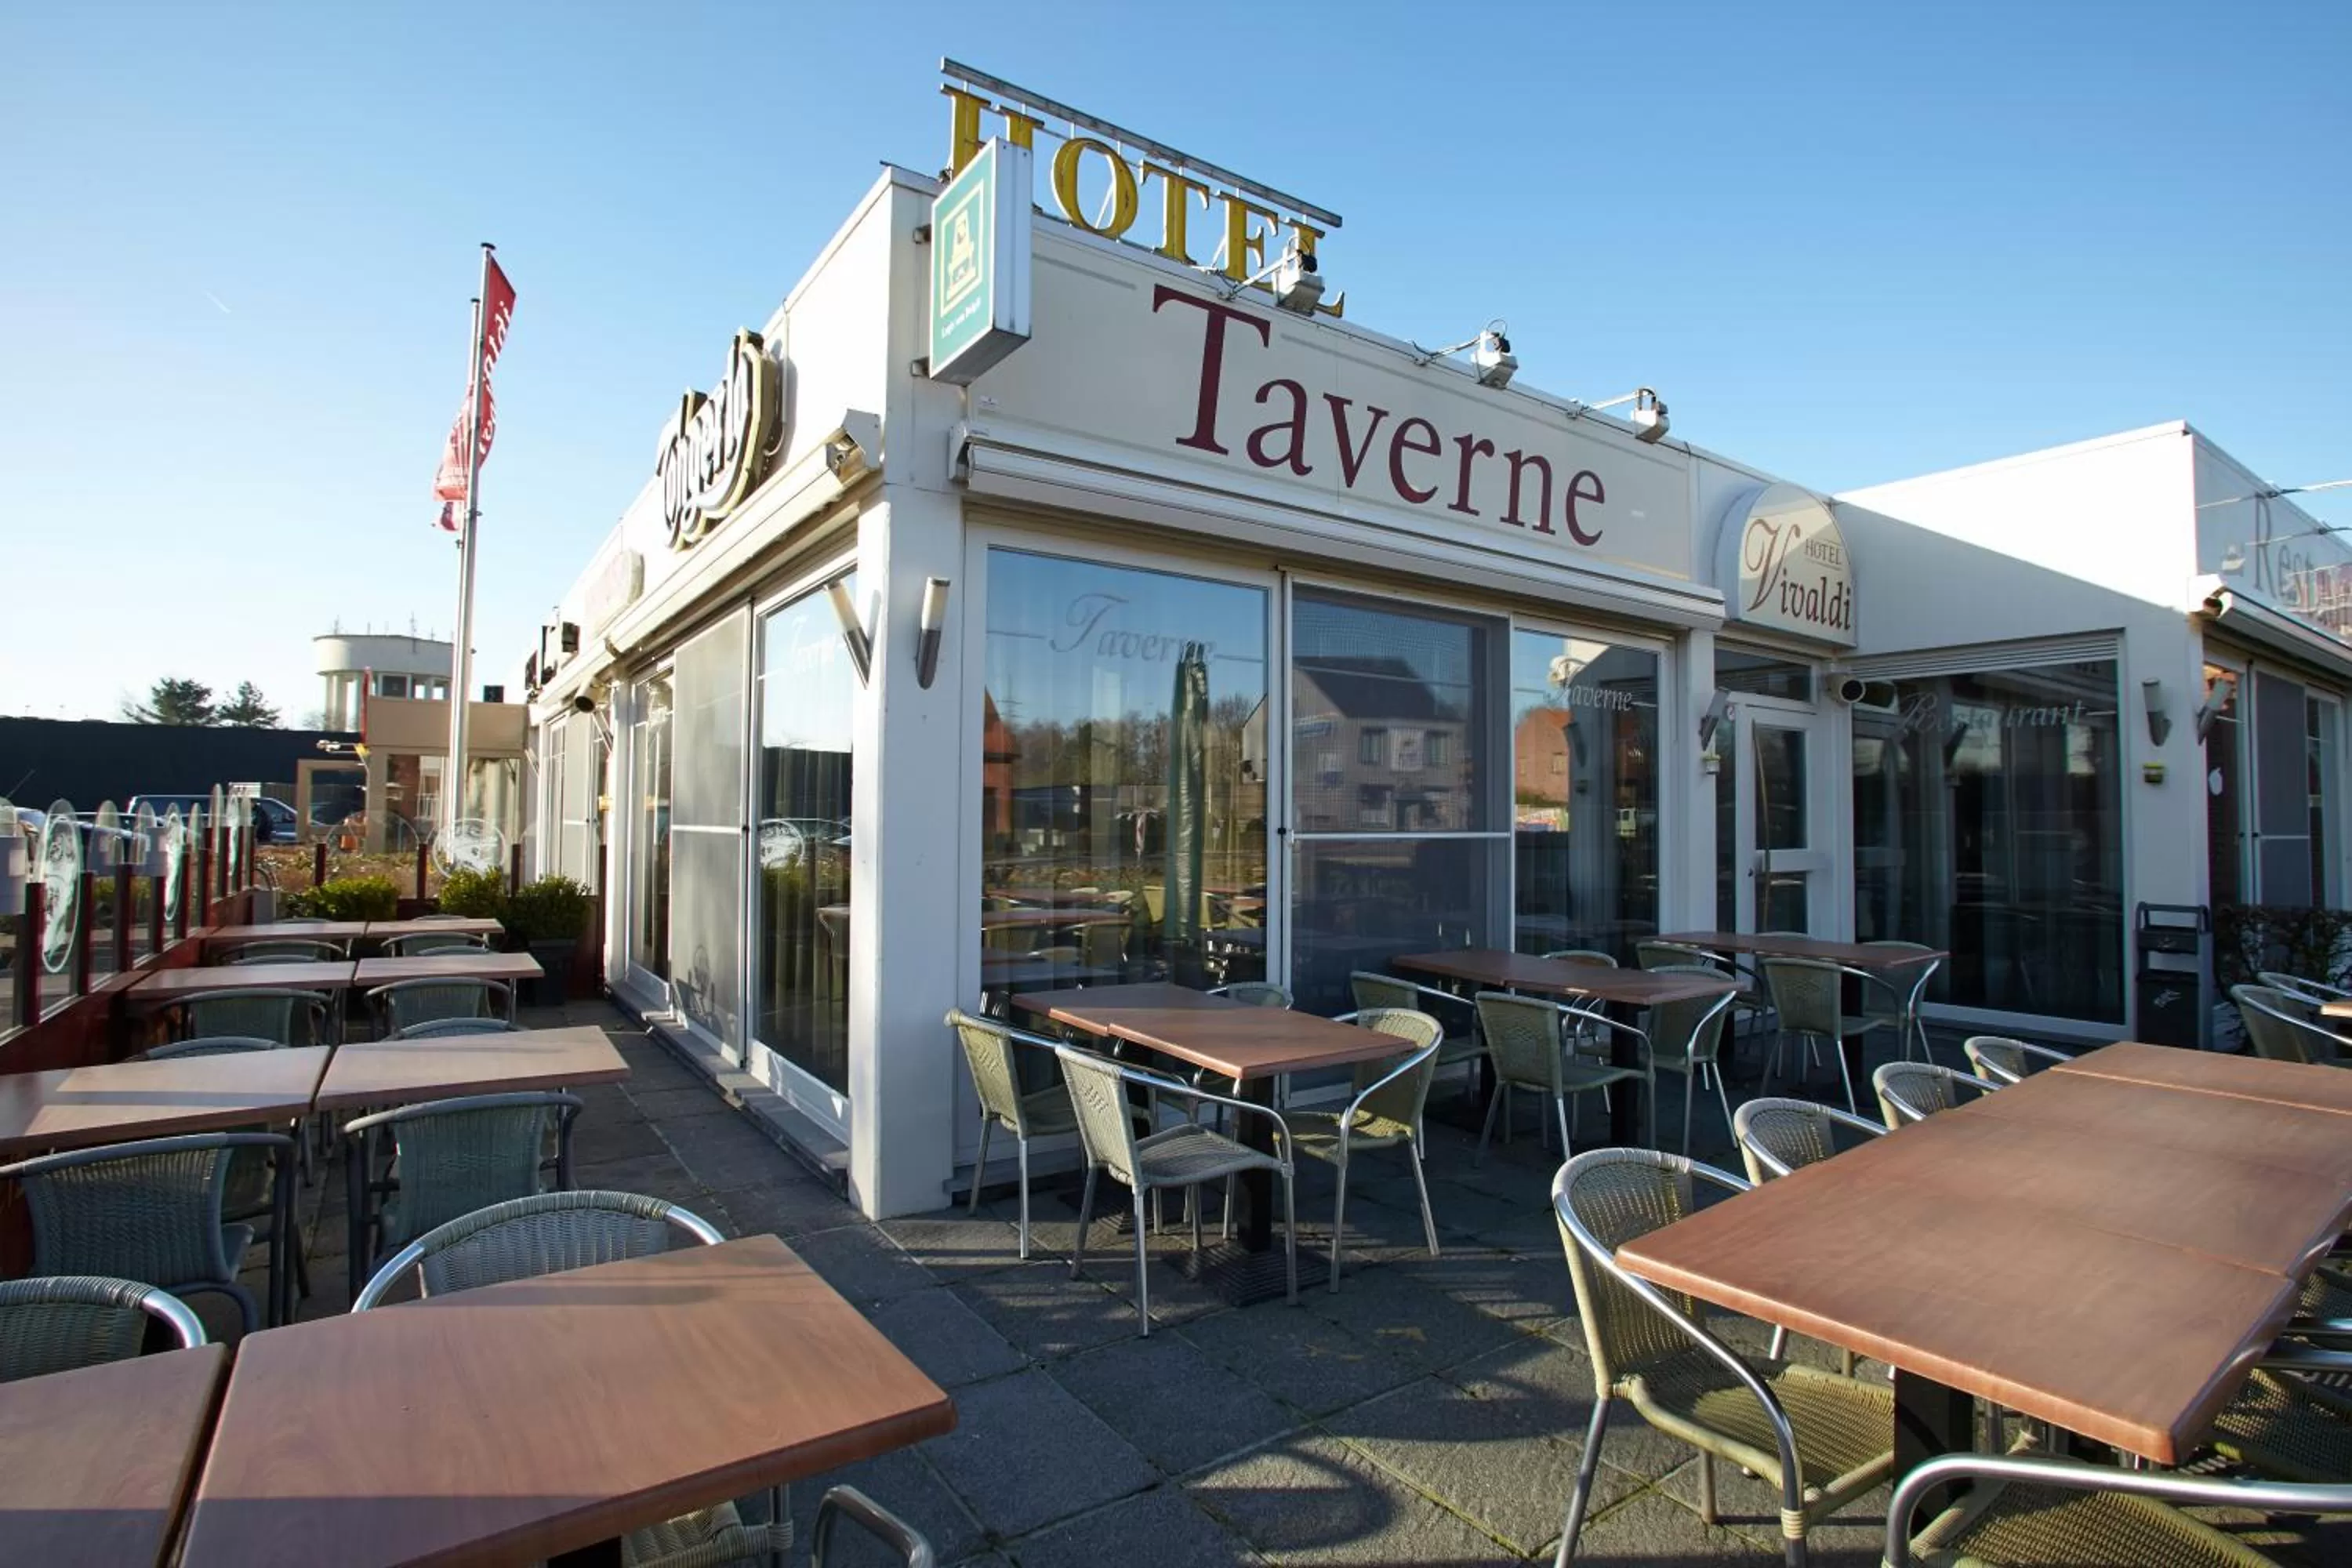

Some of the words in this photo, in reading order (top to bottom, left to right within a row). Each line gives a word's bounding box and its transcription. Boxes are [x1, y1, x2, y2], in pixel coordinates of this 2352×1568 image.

[1152, 283, 1606, 547] Taverne
[1744, 518, 1851, 630] Vivaldi
[1805, 539, 1842, 566] HOTEL
